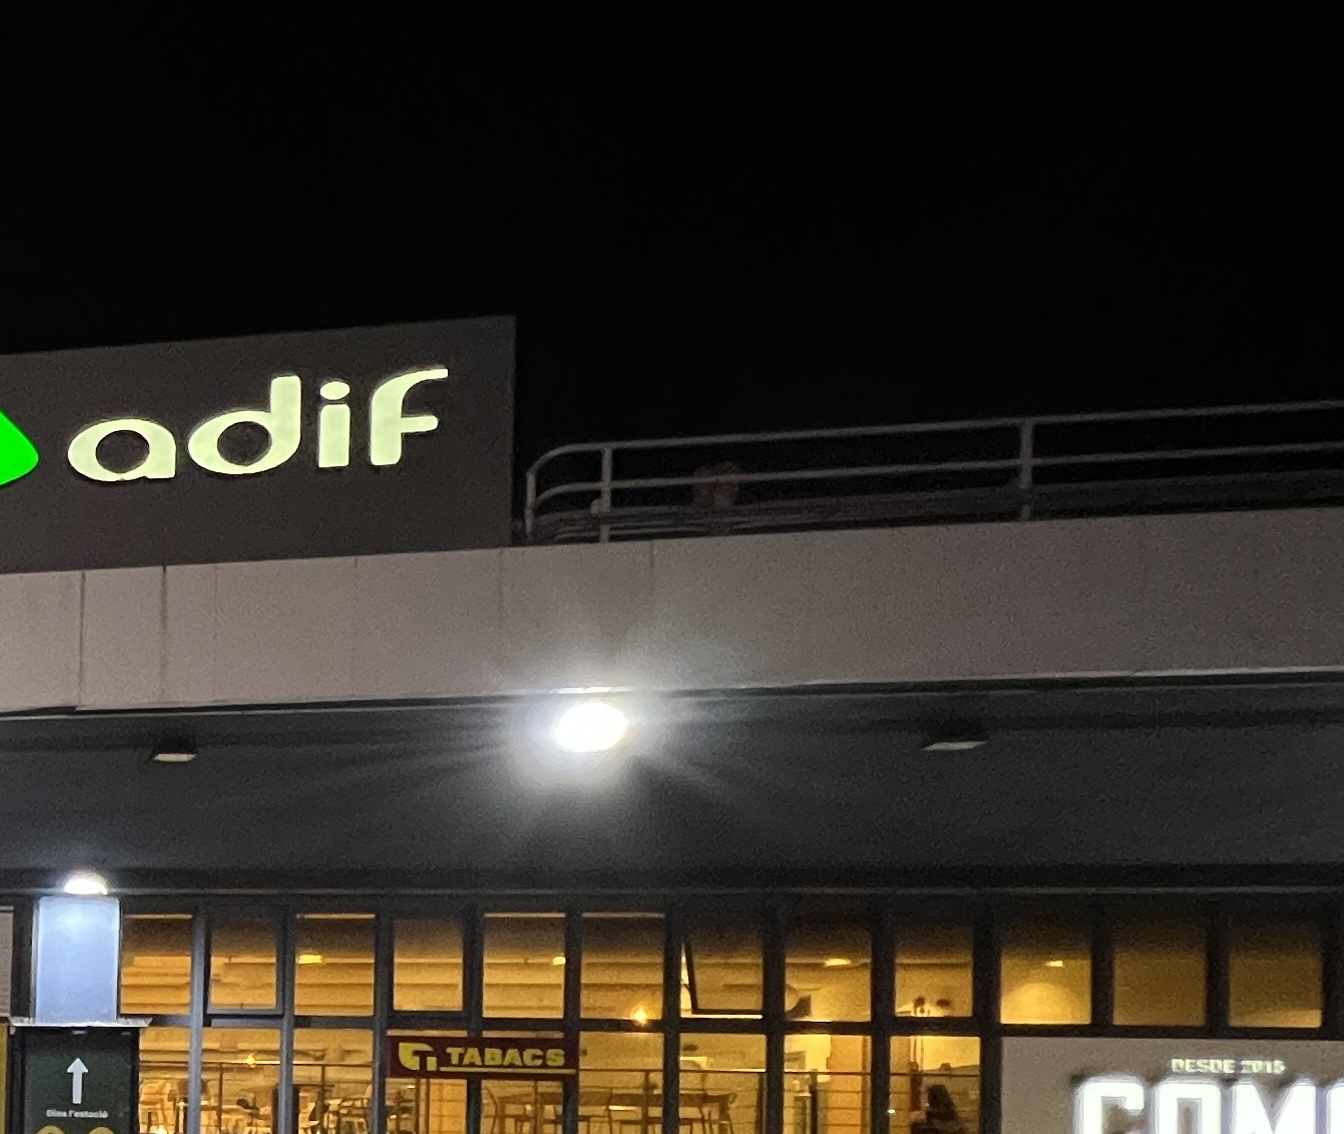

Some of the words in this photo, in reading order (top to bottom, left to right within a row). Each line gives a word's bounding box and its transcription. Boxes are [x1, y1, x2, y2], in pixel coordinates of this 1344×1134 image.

[67, 368, 449, 482] adif
[446, 1047, 566, 1067] TABACS
[1170, 1058, 1236, 1074] DESDE
